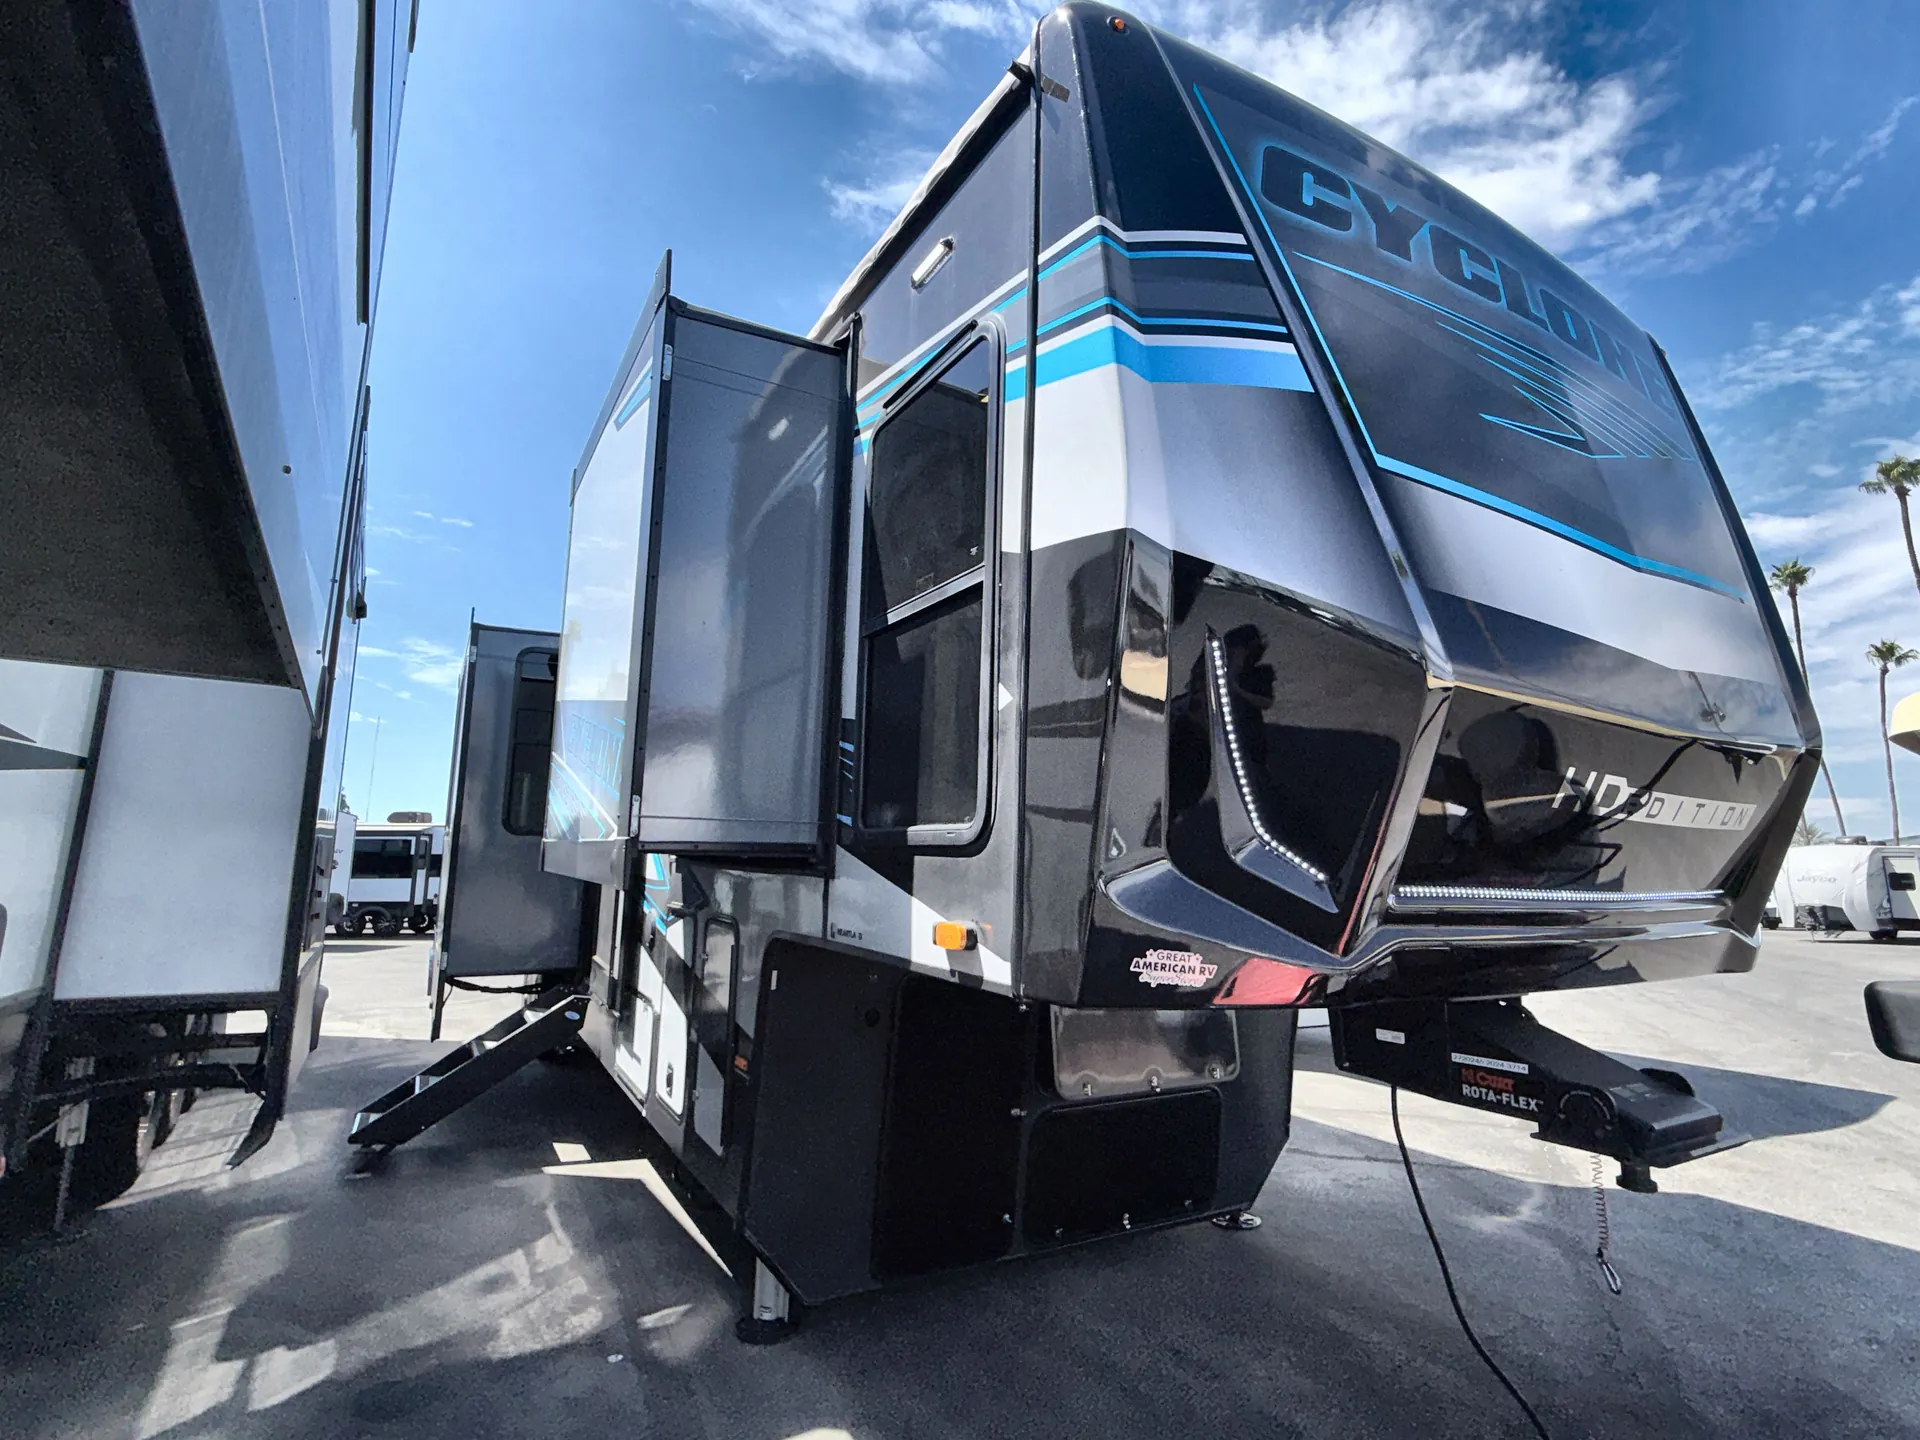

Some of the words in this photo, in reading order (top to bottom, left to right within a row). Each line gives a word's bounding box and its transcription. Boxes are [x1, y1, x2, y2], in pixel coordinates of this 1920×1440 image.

[1622, 794, 1749, 827] DITION
[1156, 951, 1192, 963] GREAT
[1132, 960, 1196, 975] AMERICAN
[1199, 966, 1216, 977] RV
